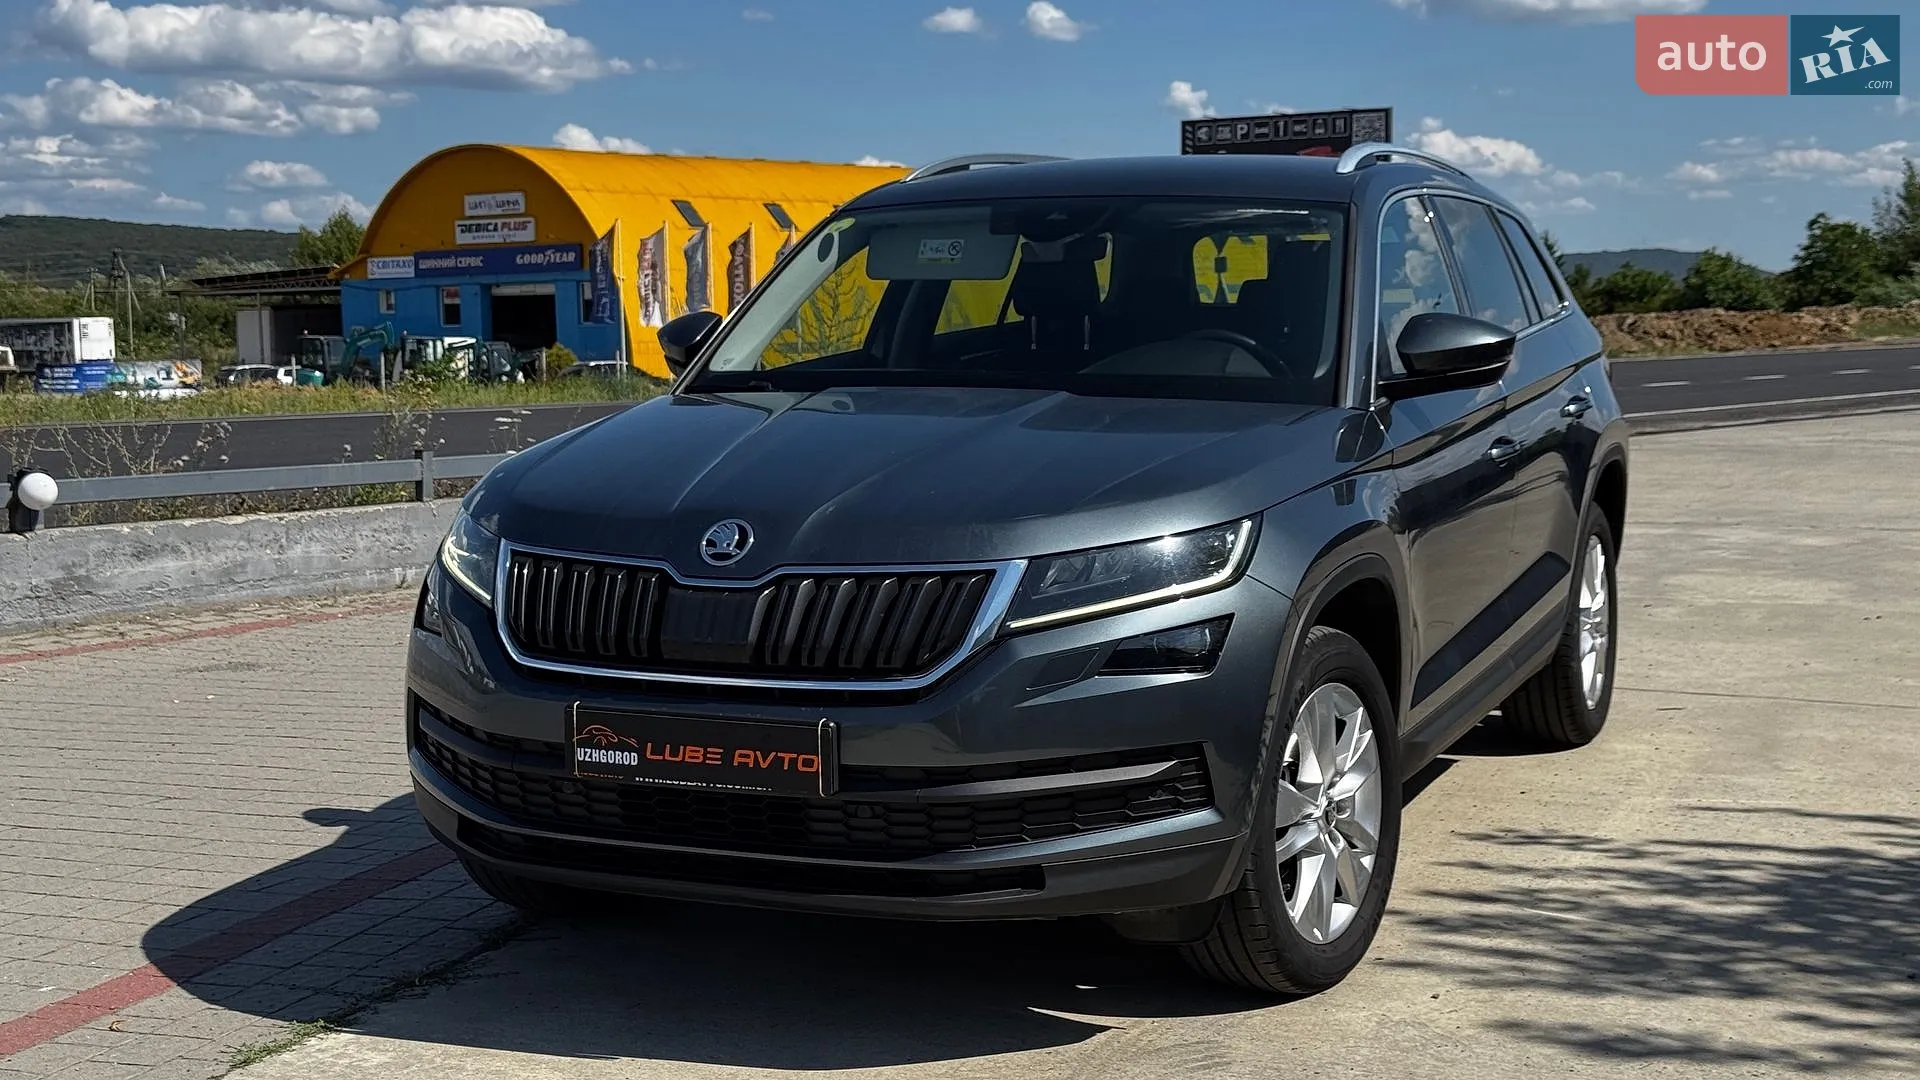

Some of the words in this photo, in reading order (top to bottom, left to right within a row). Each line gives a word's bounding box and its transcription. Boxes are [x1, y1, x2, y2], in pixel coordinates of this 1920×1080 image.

[500, 220, 532, 232] PLUS
[516, 249, 576, 266] GOODYEAR
[577, 747, 639, 766] UZHGOROD
[646, 742, 724, 765] LUBE
[733, 750, 819, 772] AVTO
